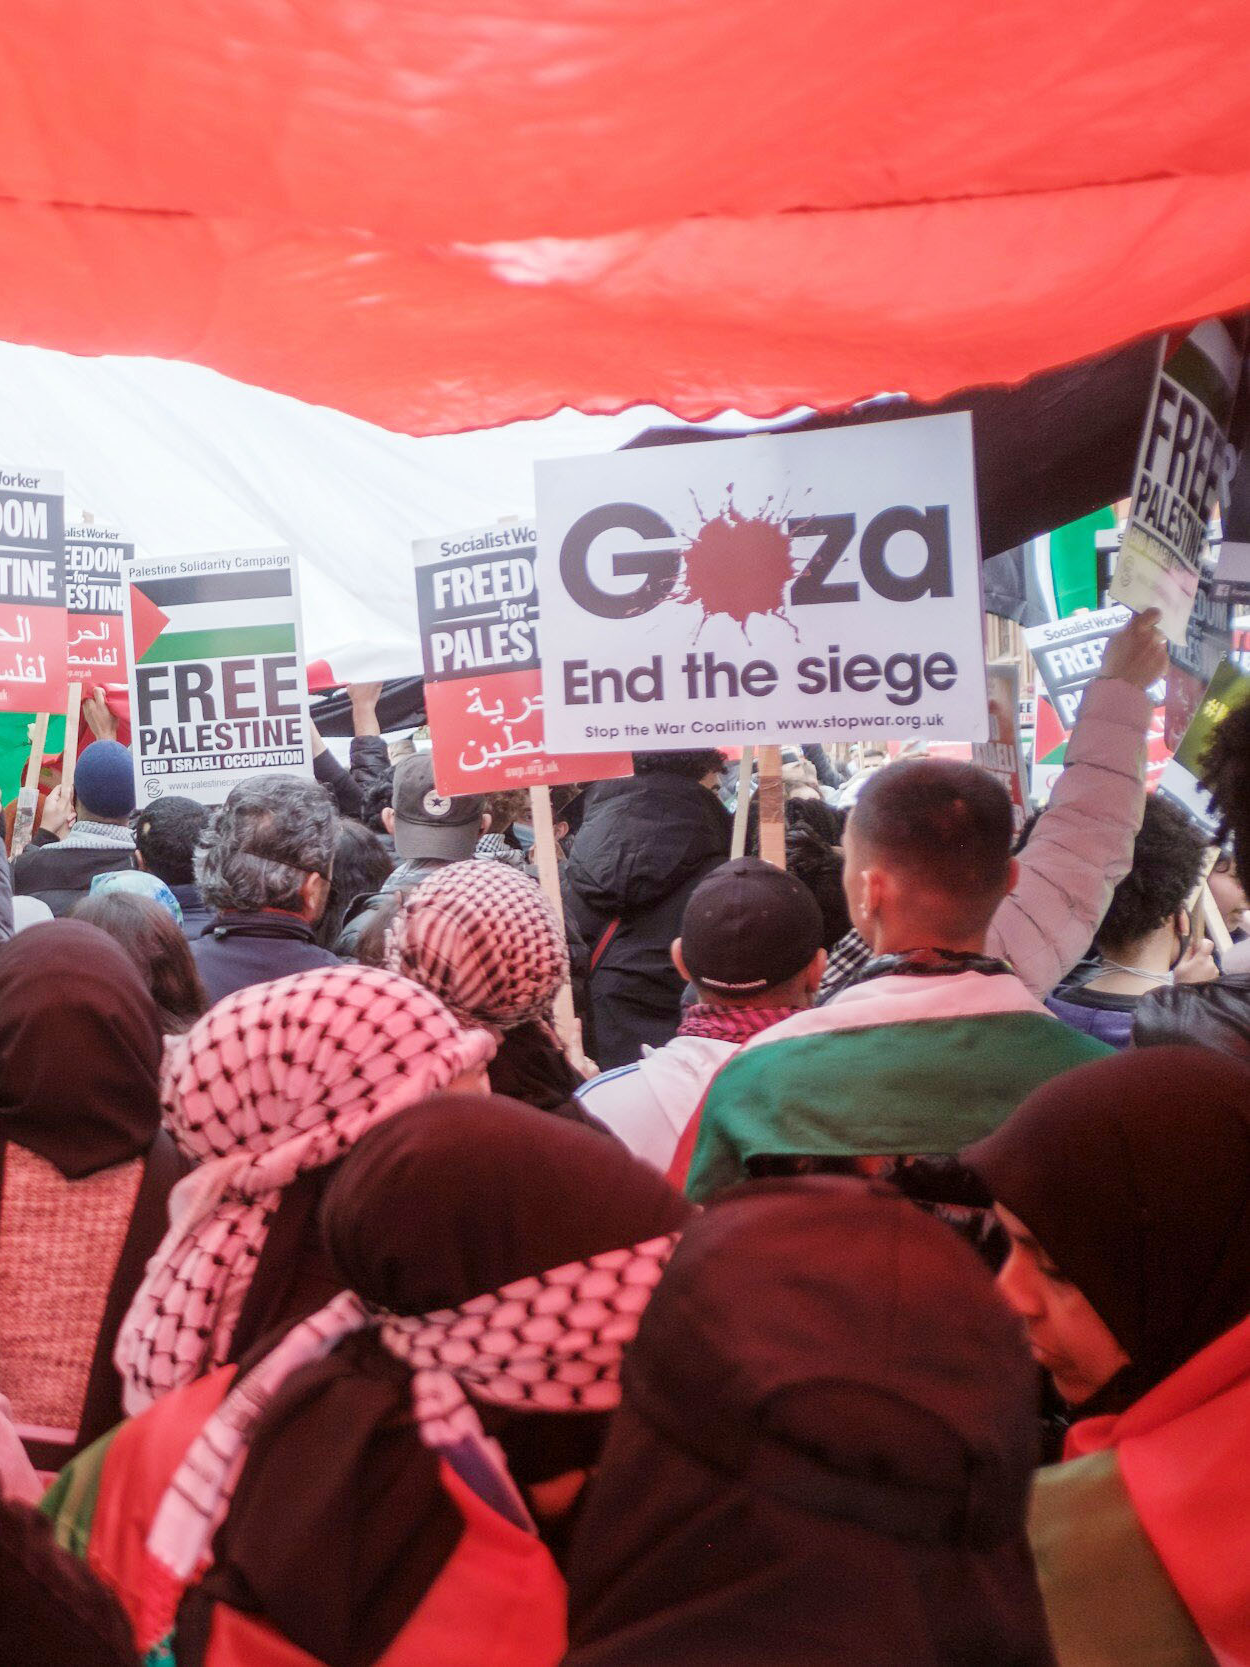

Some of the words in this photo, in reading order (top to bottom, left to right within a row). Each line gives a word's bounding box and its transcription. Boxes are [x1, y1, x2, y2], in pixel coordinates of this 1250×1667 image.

[1143, 376, 1225, 527] FREE
[64, 526, 86, 539] alist
[86, 528, 120, 541] Worker
[440, 528, 511, 557] Socialist
[129, 564, 178, 578] Palestine
[180, 559, 232, 575] Solidarity
[235, 554, 290, 570] Campaign
[558, 501, 955, 620] Gza
[73, 570, 89, 583] for
[431, 557, 538, 611] FREED
[500, 600, 528, 620] for
[1043, 619, 1095, 641] Socialist
[1095, 610, 1133, 628] Worker
[430, 618, 542, 673] PALEST
[135, 655, 302, 727] FREE
[563, 654, 664, 706] End
[681, 651, 779, 700] the
[796, 645, 959, 706] siege
[139, 717, 303, 756] PALESTINE
[585, 725, 621, 740] Stop
[625, 724, 650, 737] the
[654, 721, 686, 735] War
[691, 718, 767, 733] Coalition
[777, 714, 945, 732] www.stopwar.org.uk
[142, 758, 169, 774] END
[171, 756, 221, 772] ISRAELI
[223, 750, 303, 769] OCCUPATION
